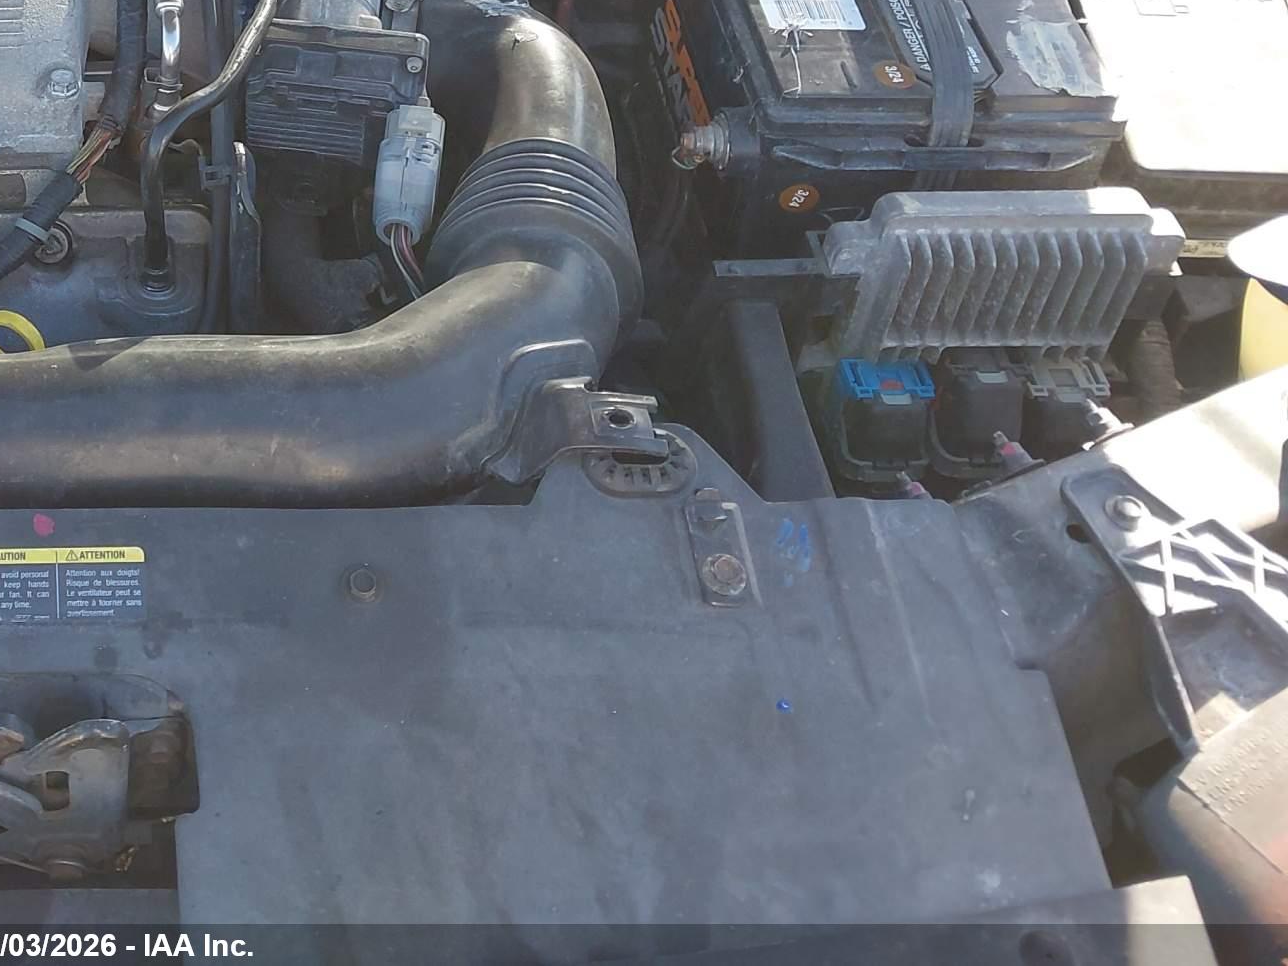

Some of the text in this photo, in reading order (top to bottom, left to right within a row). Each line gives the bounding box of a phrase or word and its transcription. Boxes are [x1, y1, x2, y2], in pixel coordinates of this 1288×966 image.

[903, 28, 927, 63] DANGER
[884, 65, 904, 83] 3/24
[789, 189, 809, 207] 3/24
[79, 550, 125, 560] ATTENTION
[1, 570, 19, 579] avoid
[21, 570, 49, 579] personal
[4, 581, 21, 589] keep
[66, 579, 90, 588] Risque
[66, 589, 75, 597] Le
[115, 589, 130, 597] peut
[1, 602, 13, 610] any
